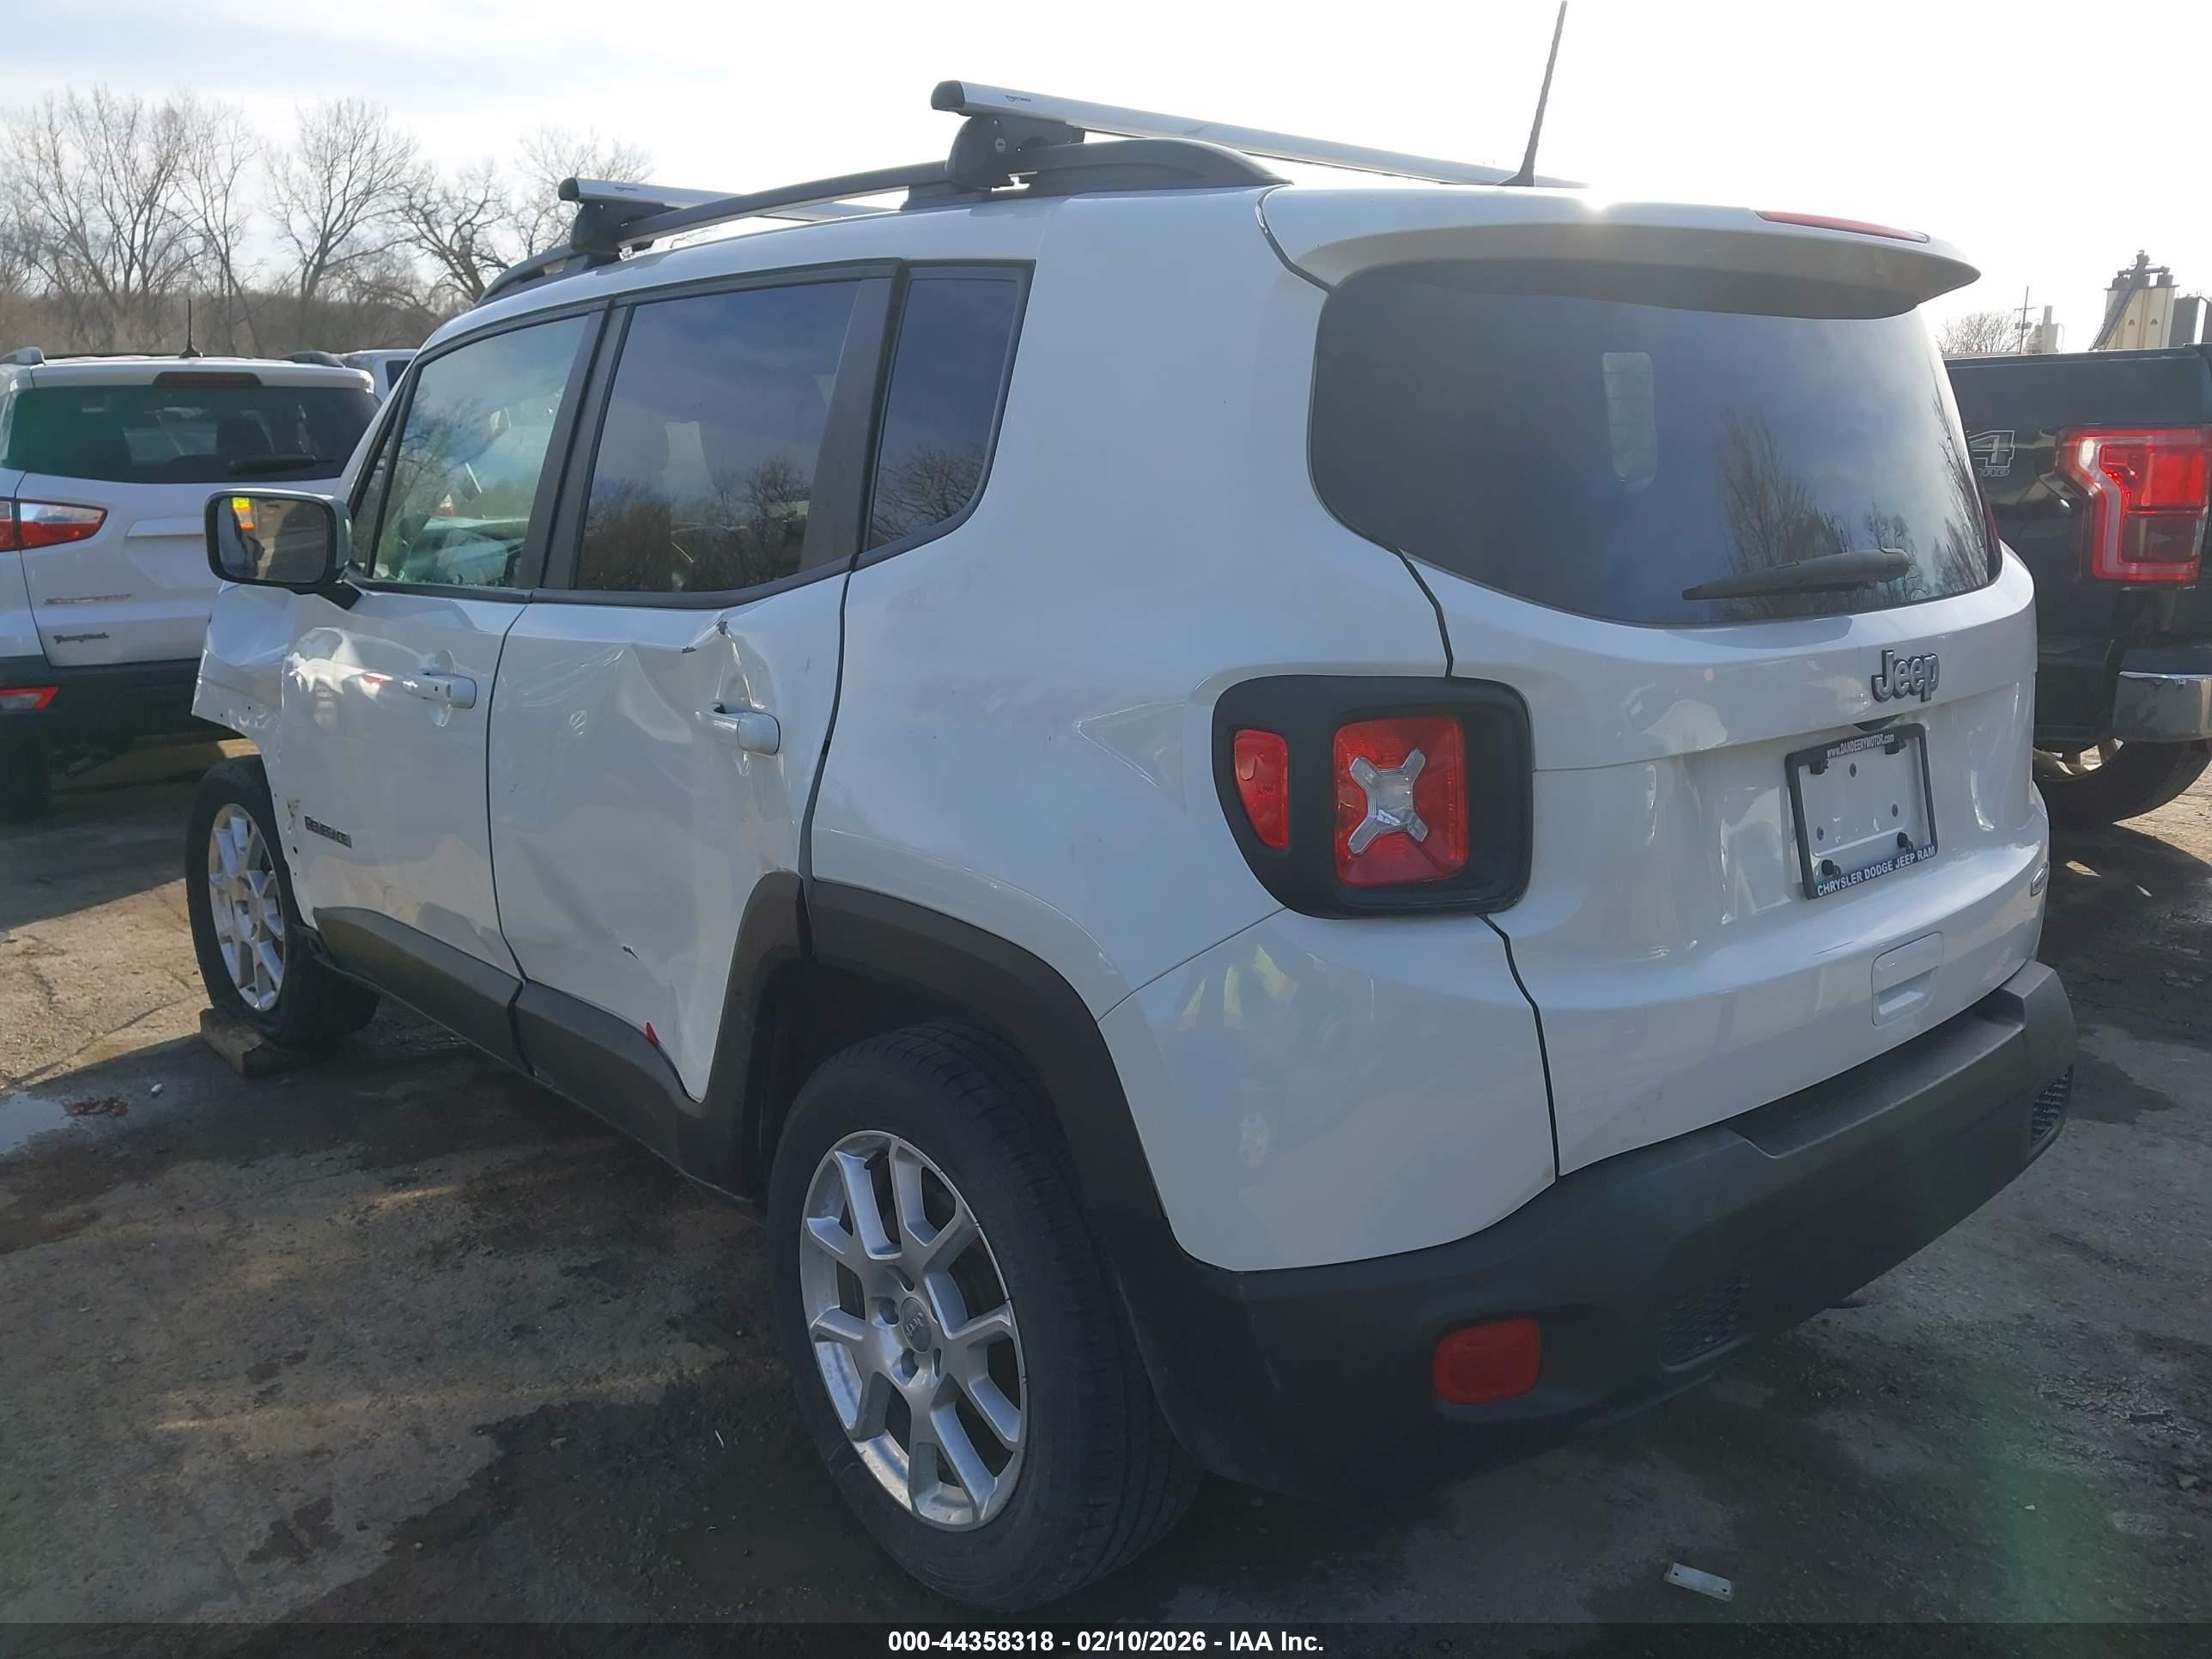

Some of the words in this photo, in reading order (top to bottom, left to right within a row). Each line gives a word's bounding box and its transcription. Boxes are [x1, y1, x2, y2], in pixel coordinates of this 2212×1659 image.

[1871, 649, 1940, 702] Jeep
[1817, 872, 1863, 896] CHRYSLER
[1864, 860, 1894, 880] DODGE
[1895, 853, 1916, 869] JEEP
[1917, 845, 1936, 861] RAM
